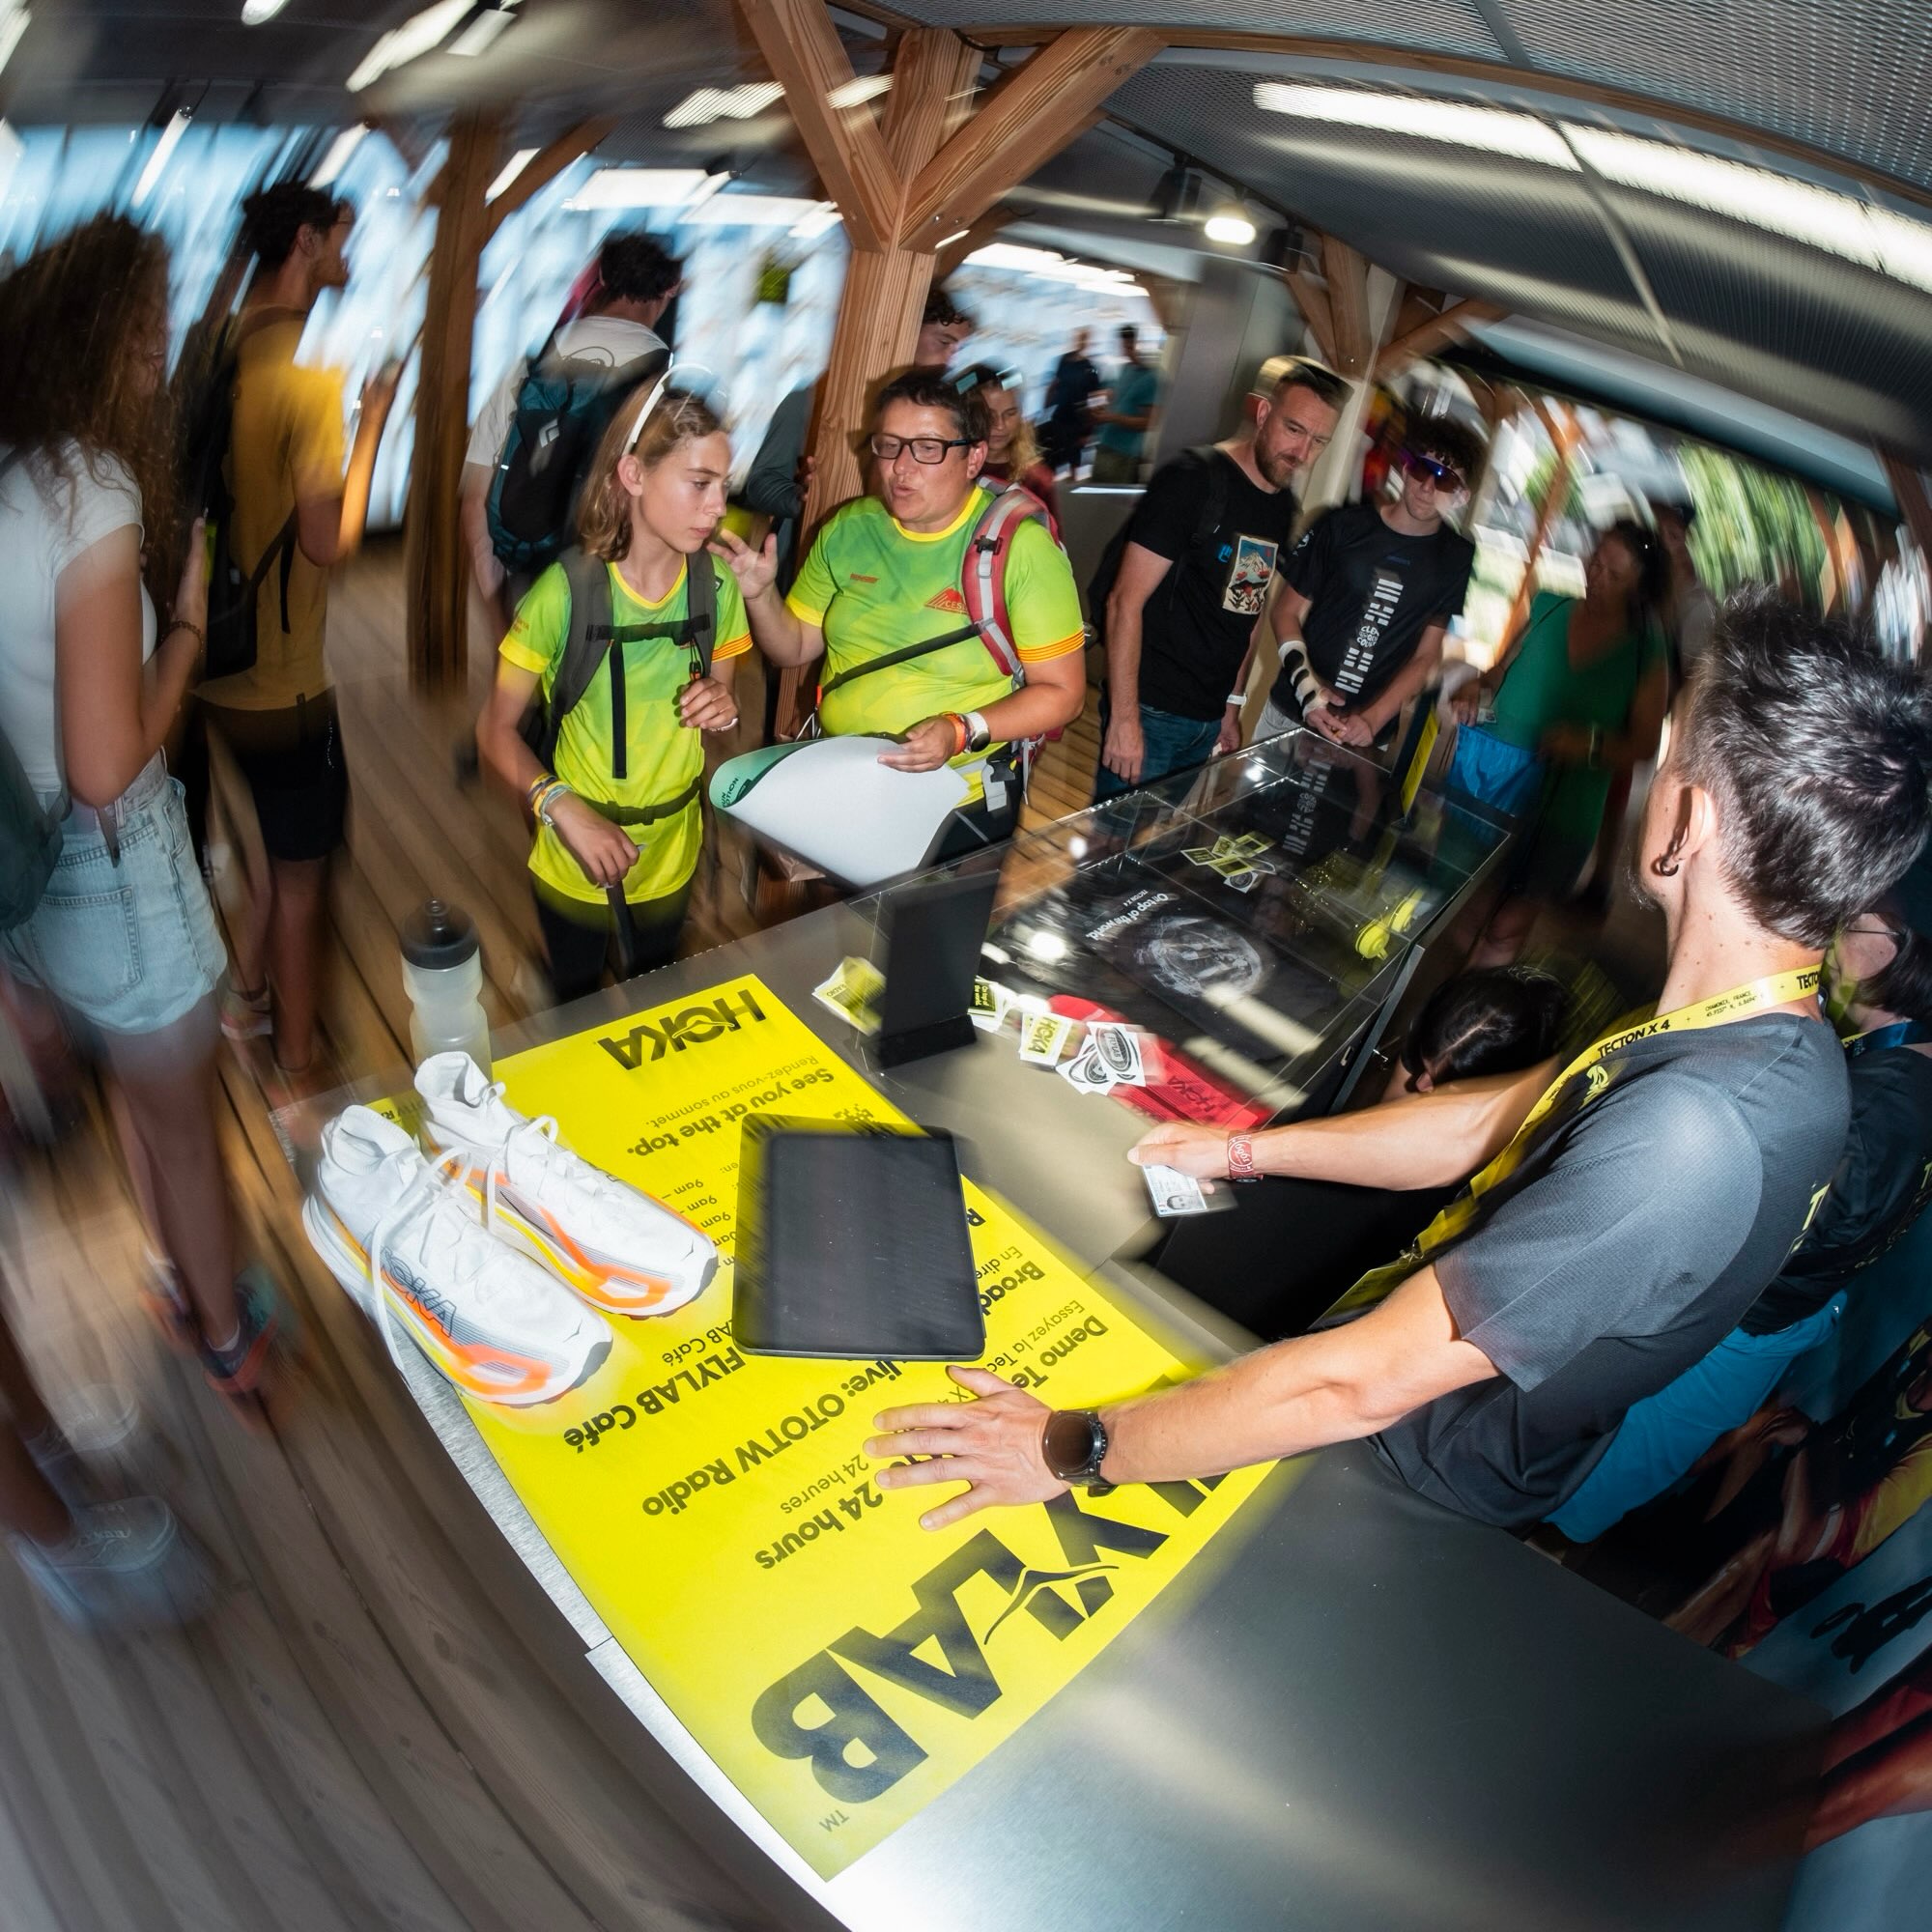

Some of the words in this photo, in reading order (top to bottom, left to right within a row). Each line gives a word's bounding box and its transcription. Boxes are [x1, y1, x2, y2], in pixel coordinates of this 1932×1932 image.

[1796, 970, 1819, 990] TECTO
[597, 989, 767, 1070] HOKA
[1028, 1017, 1059, 1054] HOKA
[1597, 1027, 1647, 1059] TECTON
[1648, 1022, 1661, 1035] X
[1661, 1019, 1671, 1031] 4
[733, 1055, 819, 1095] Rendez-vous
[789, 1067, 835, 1092] See
[712, 1088, 731, 1103] au
[750, 1082, 791, 1110] you
[645, 1099, 711, 1130] sommet.
[679, 1116, 723, 1139] the
[722, 1105, 749, 1123] at
[627, 1132, 680, 1157] top.
[673, 1179, 704, 1195] 9am
[687, 1195, 718, 1211] 9am
[700, 1211, 731, 1228] 9am
[976, 1258, 1001, 1279] dire
[1001, 1245, 1023, 1262] En
[1028, 1299, 1085, 1343] Essayez
[662, 1337, 706, 1367] Café
[1012, 1337, 1033, 1353] la
[1039, 1315, 1109, 1367] Demo
[985, 1351, 1018, 1373] Tec
[636, 1346, 747, 1415] FLYLAB
[840, 1359, 903, 1397] live:
[563, 1405, 637, 1454] Café
[734, 1393, 845, 1474] OTOTW
[842, 1454, 869, 1479] 24
[641, 1458, 736, 1516] Radio
[781, 1470, 846, 1514] heures
[838, 1481, 883, 1521] 24
[754, 1508, 845, 1569] hours
[752, 1376, 1233, 1804] YLAB
